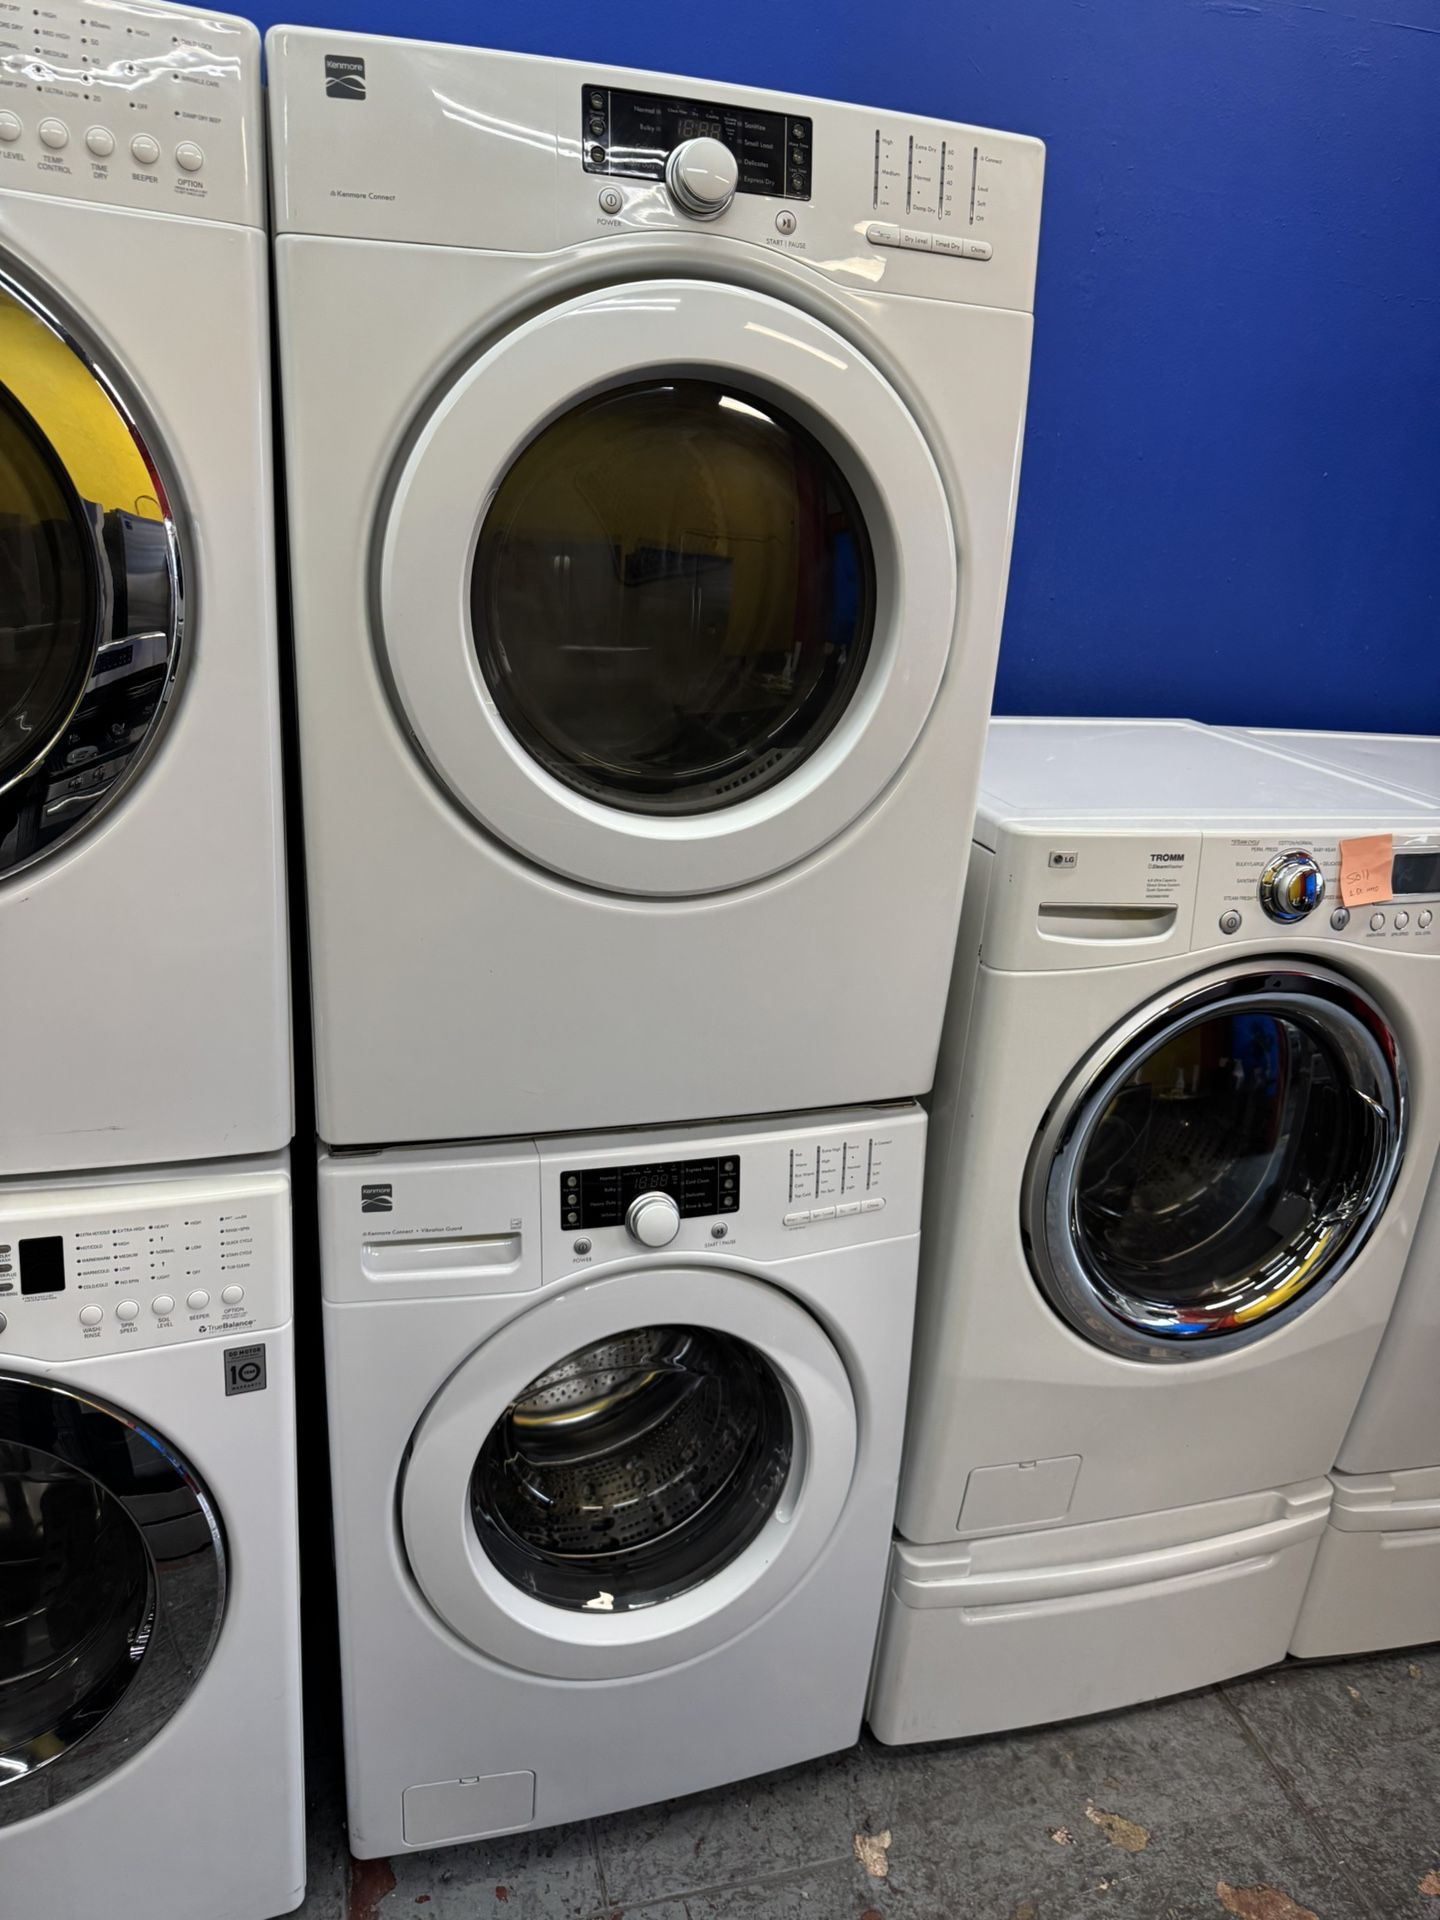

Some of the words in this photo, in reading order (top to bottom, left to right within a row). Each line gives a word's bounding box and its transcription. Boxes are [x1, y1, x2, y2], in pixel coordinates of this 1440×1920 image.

[90, 38, 100, 46] 50
[43, 49, 69, 59] MEDIUM
[326, 59, 364, 72] Kenmore
[634, 105, 655, 115] Normal
[640, 123, 655, 133] Bulky
[744, 122, 766, 131] Sanitize
[744, 139, 760, 147] Small
[3, 152, 26, 162] LEVEL
[984, 156, 1002, 164] Connect
[37, 162, 72, 174] CONTROL
[91, 163, 108, 172] TIME
[744, 159, 769, 168] Delicates
[93, 171, 108, 180] DRY
[882, 169, 900, 177] Medium
[131, 172, 159, 184] BEEPER
[744, 176, 764, 185] Express
[765, 178, 776, 187] Dry
[914, 174, 931, 182] Normal
[177, 178, 204, 189] OPTION
[337, 190, 367, 199] Kenmore
[368, 192, 396, 201] Connect
[913, 205, 927, 213] Damp
[597, 218, 621, 227] POWER
[766, 238, 784, 247] START
[788, 241, 806, 249] PAUSE
[905, 235, 914, 243] Dry
[935, 240, 950, 248] Timed
[951, 242, 960, 250] Dry
[971, 246, 986, 254] Chime
[1150, 853, 1185, 862] TROMM
[224, 1306, 244, 1314] OPTION
[189, 1313, 210, 1321] BEEPER
[120, 1327, 138, 1335] SPEED
[239, 1347, 261, 1355] MOTOR
[230, 1362, 261, 1385] 10
